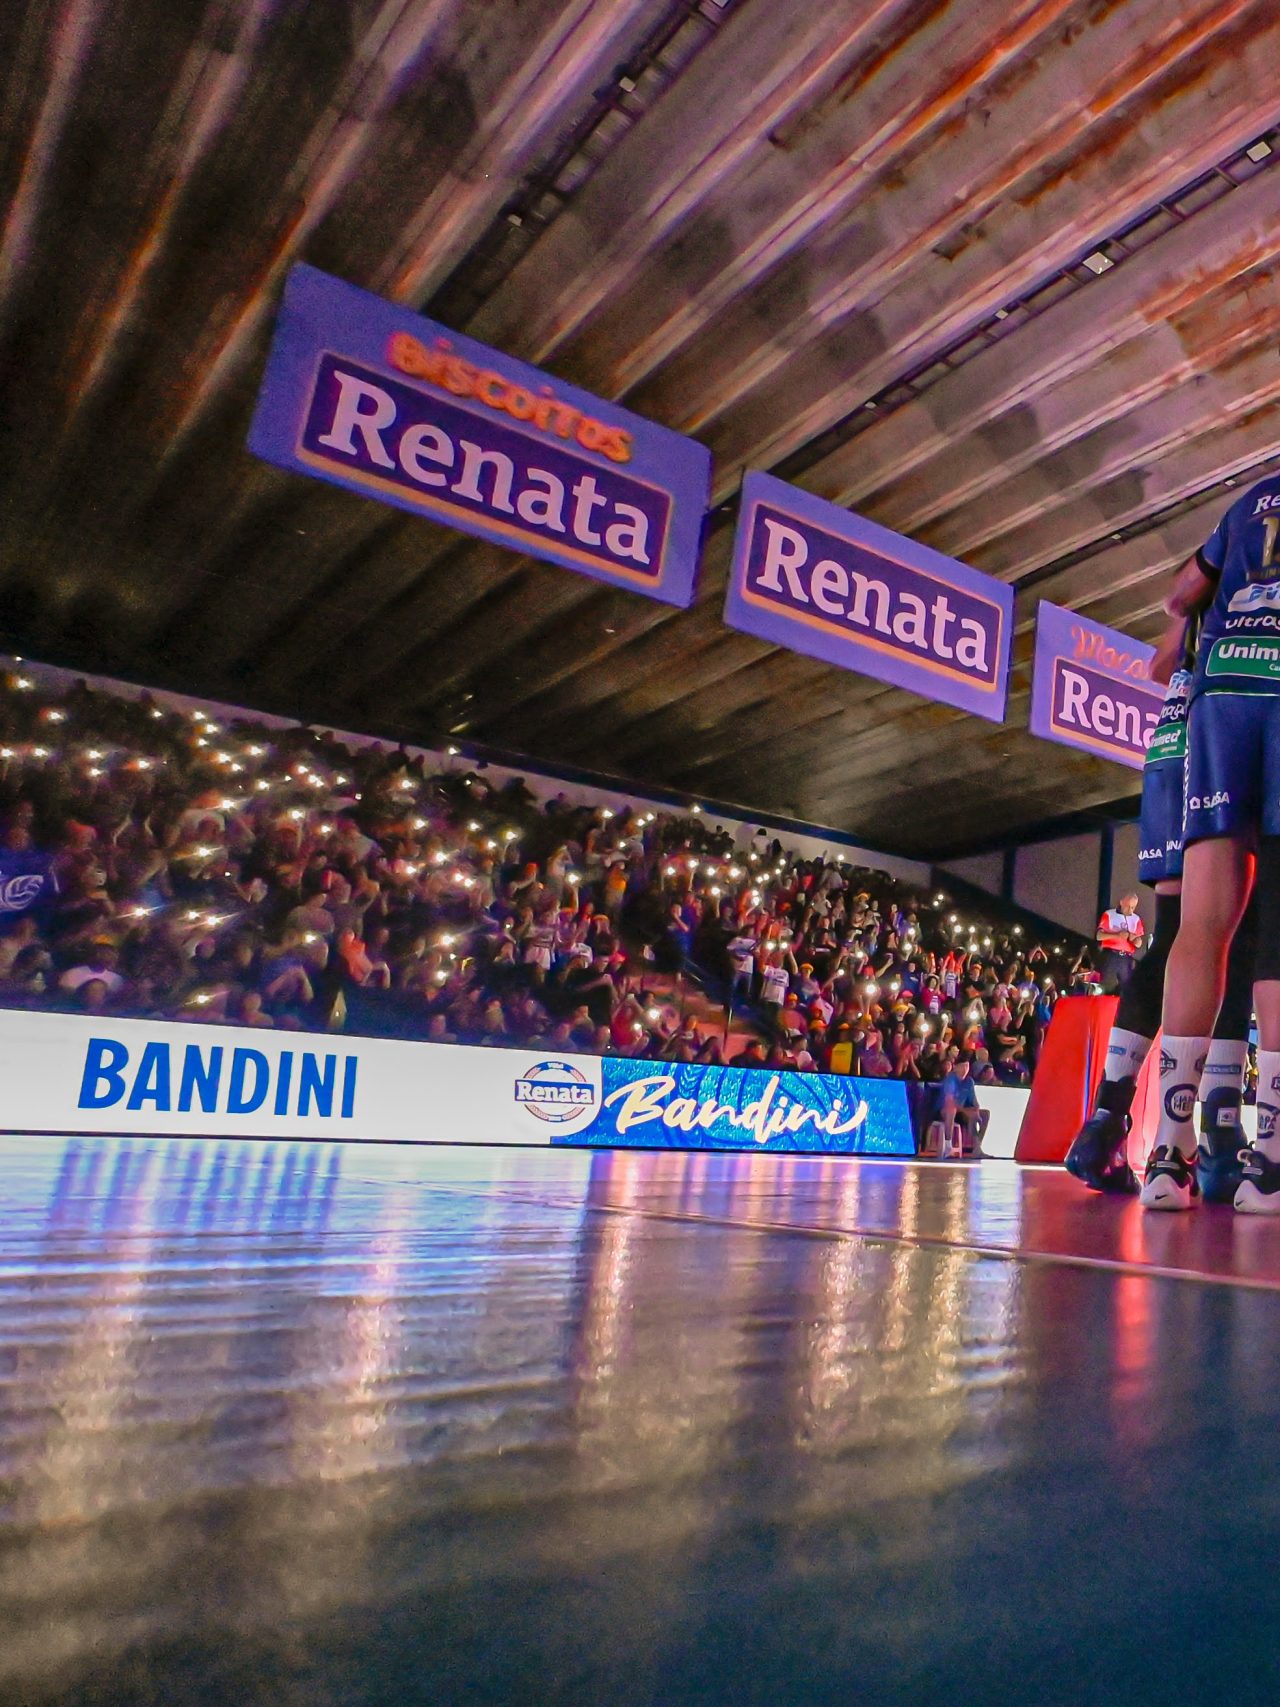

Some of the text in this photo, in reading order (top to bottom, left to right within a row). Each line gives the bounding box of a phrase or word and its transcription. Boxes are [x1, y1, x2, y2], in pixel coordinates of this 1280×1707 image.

[318, 370, 651, 564] Renata
[756, 518, 989, 673] Renata
[78, 1038, 358, 1118] BANDINI
[516, 1081, 593, 1104] Renata
[604, 1076, 867, 1144] Bandini
